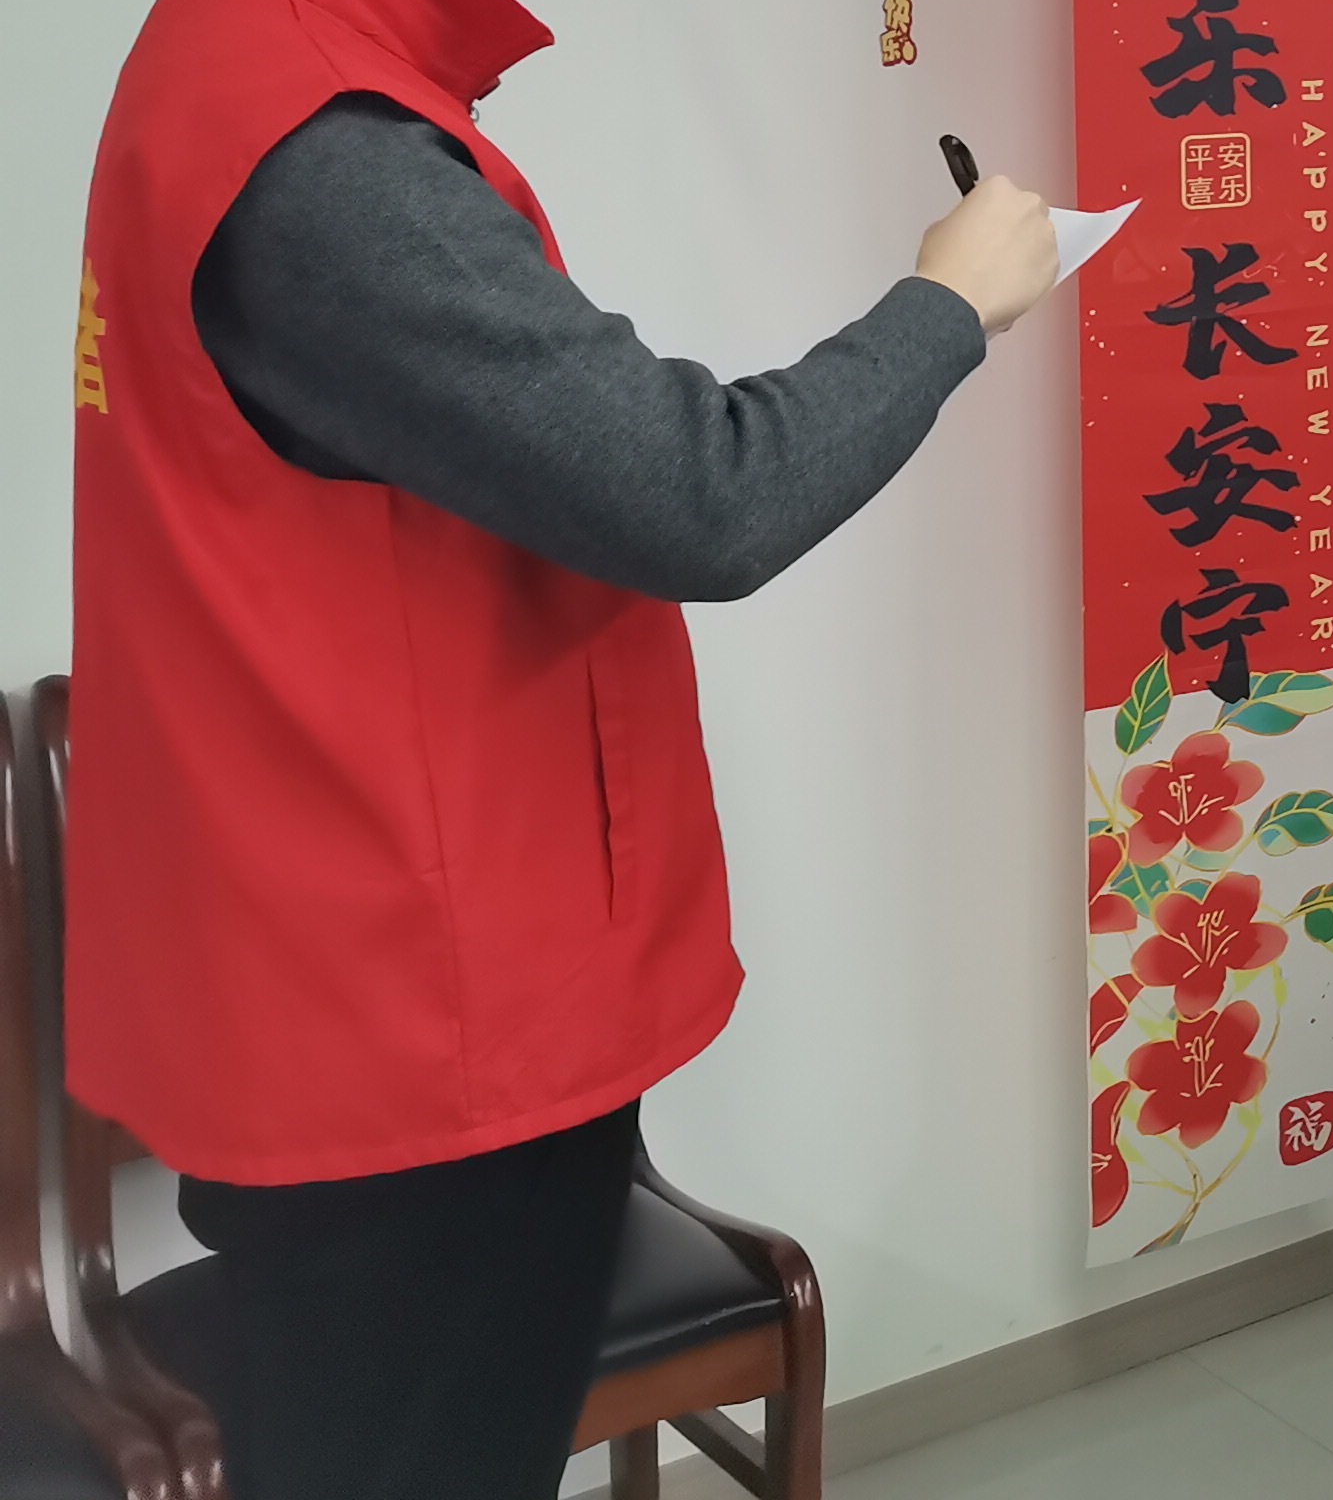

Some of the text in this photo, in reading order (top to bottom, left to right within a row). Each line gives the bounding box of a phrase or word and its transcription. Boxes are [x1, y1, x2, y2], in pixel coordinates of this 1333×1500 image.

[1186, 142, 1245, 171] 平安
[1186, 174, 1245, 204] 喜乐
[1301, 79, 1333, 641] HAPPY NEW YEAR
[1144, 242, 1299, 705] 长安宁
[1283, 1101, 1332, 1153] 福
